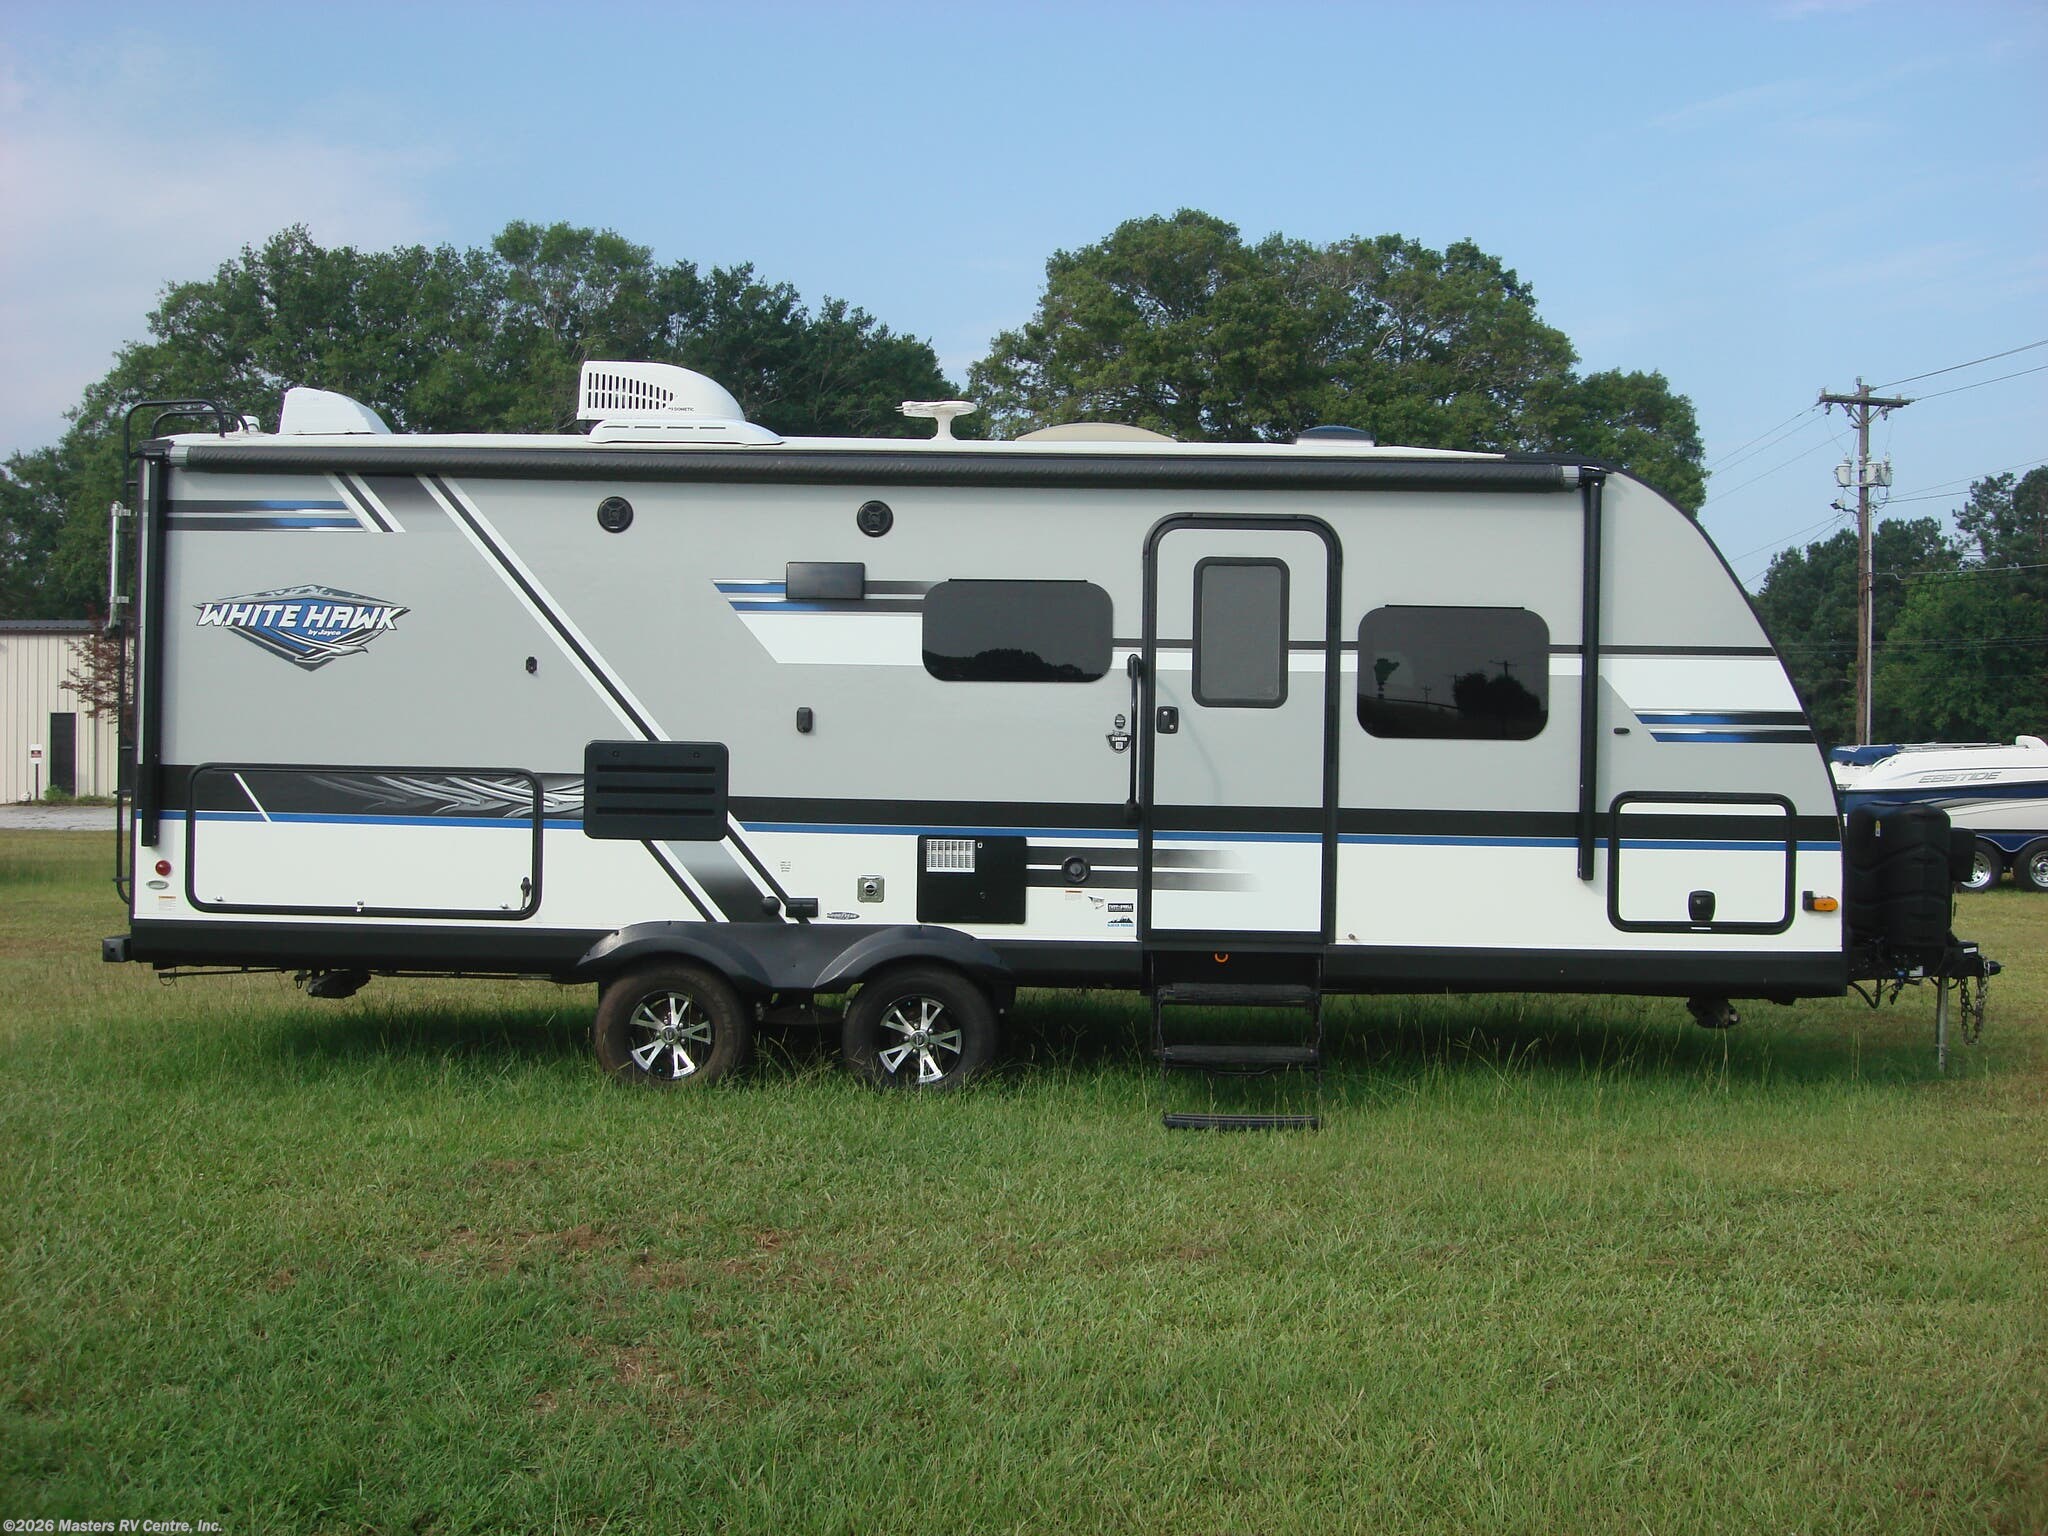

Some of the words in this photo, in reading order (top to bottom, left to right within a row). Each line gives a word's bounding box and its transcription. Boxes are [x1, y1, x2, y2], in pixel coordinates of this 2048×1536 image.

[197, 603, 302, 627] WHITE
[303, 605, 405, 630] HAWK
[307, 629, 317, 637] by
[318, 629, 341, 637] Jayco
